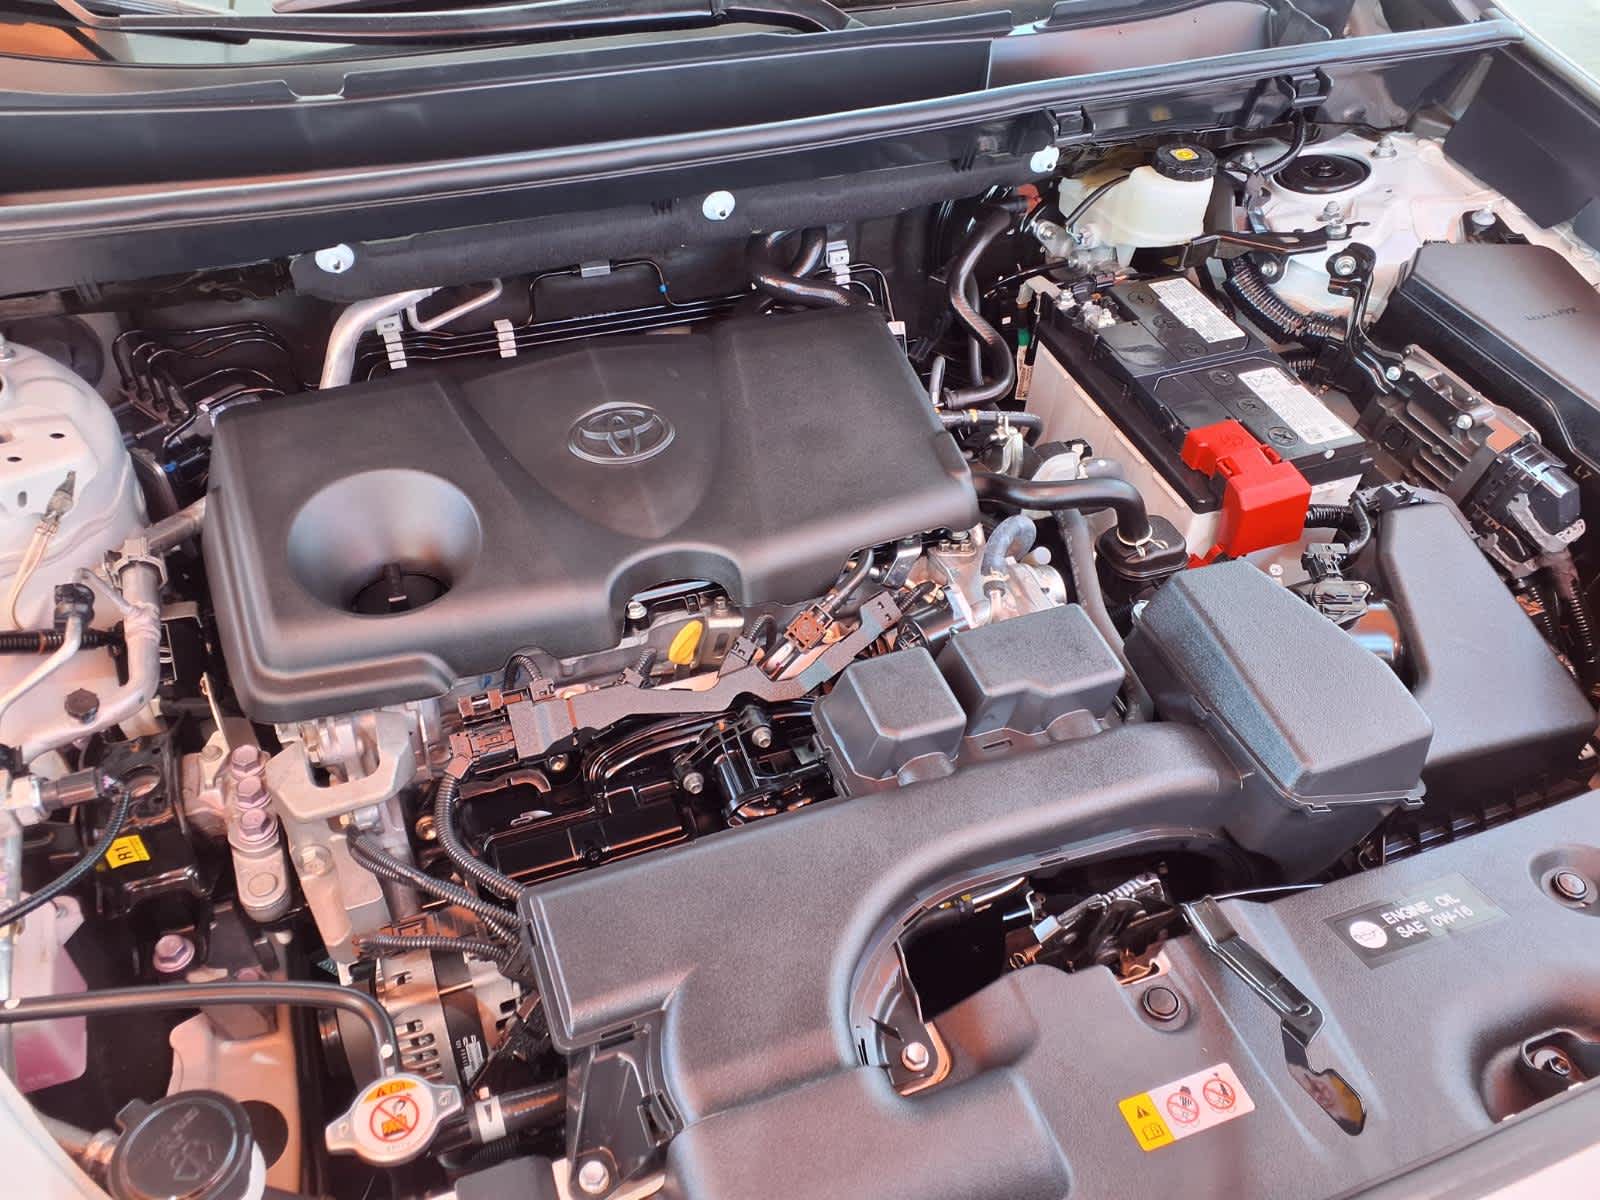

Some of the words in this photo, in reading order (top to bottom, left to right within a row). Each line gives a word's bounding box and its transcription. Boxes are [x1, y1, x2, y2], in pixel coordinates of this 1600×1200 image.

[1381, 900, 1433, 925] ENGINE
[1434, 893, 1460, 908] OIL
[1395, 920, 1428, 938] SAE
